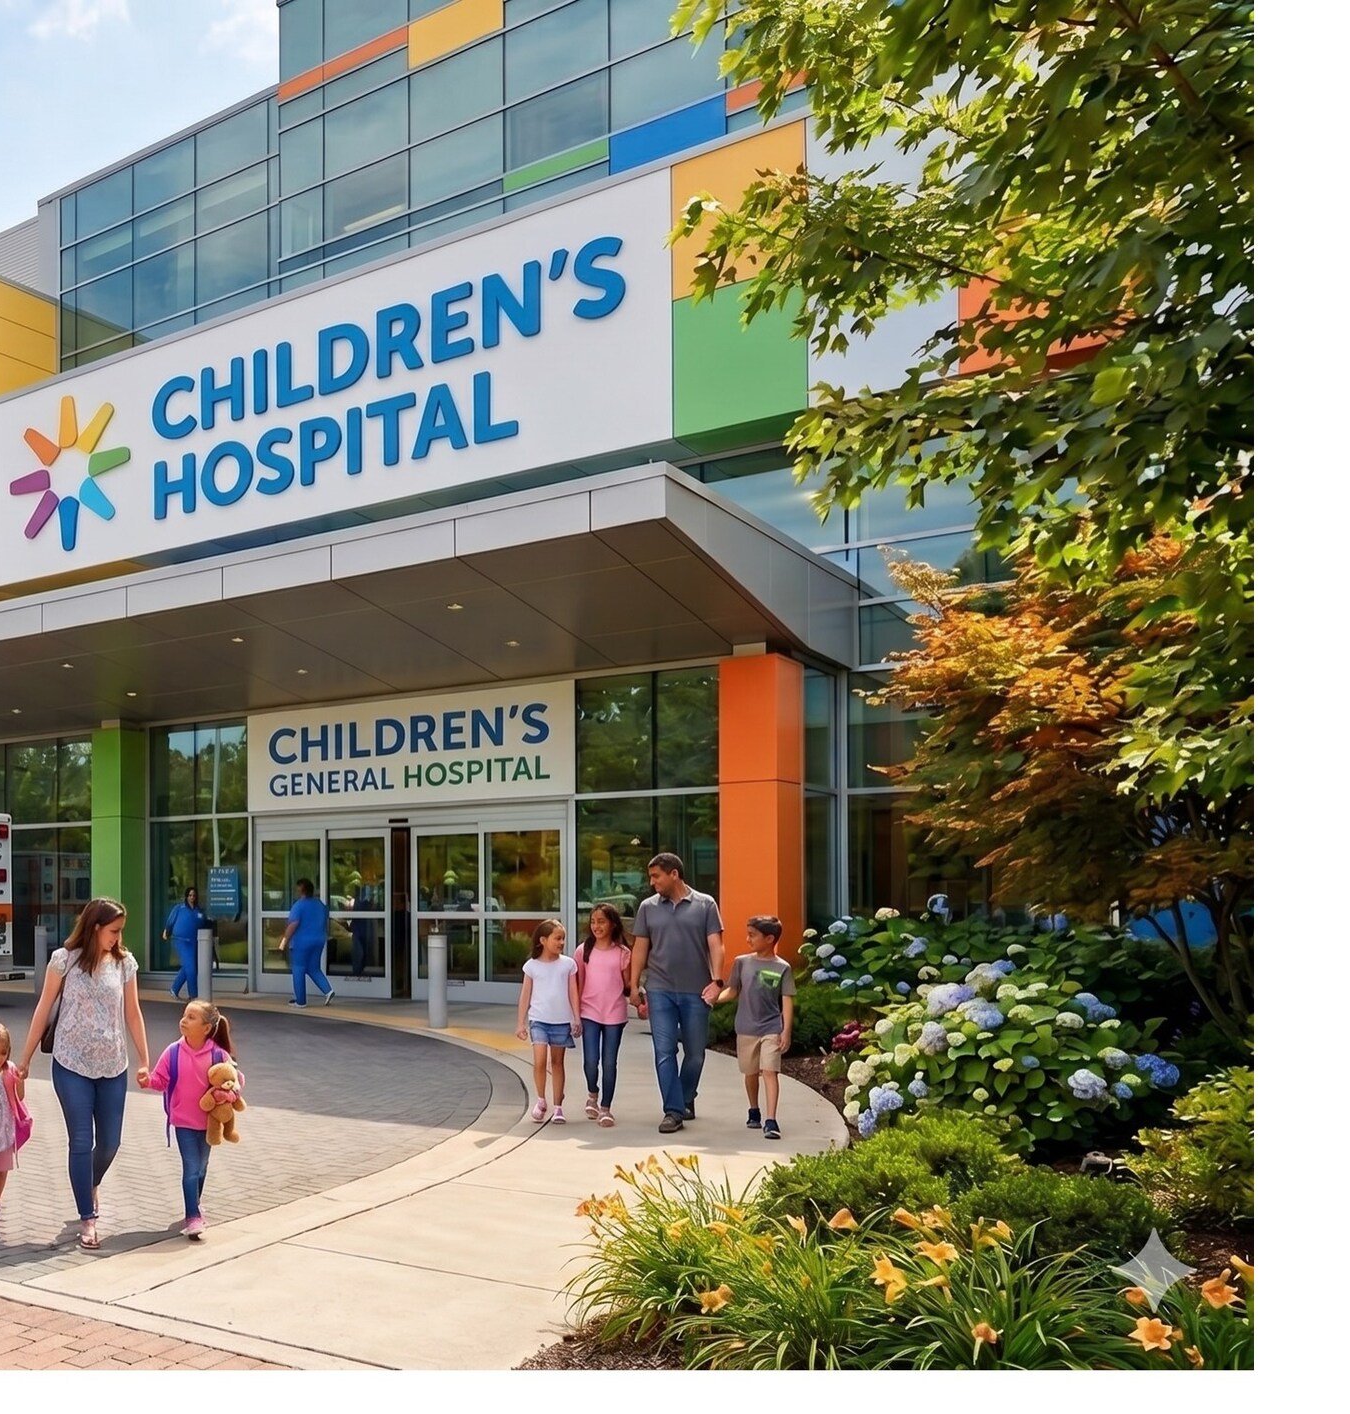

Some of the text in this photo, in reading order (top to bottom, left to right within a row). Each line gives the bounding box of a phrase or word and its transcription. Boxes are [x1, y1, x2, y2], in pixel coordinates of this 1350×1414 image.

[152, 236, 626, 440] CHILDREN'S
[153, 371, 519, 521] HOSPITAL
[268, 703, 550, 765] CHILDREN'S
[269, 755, 550, 797] GENERAL HOSPITAL
